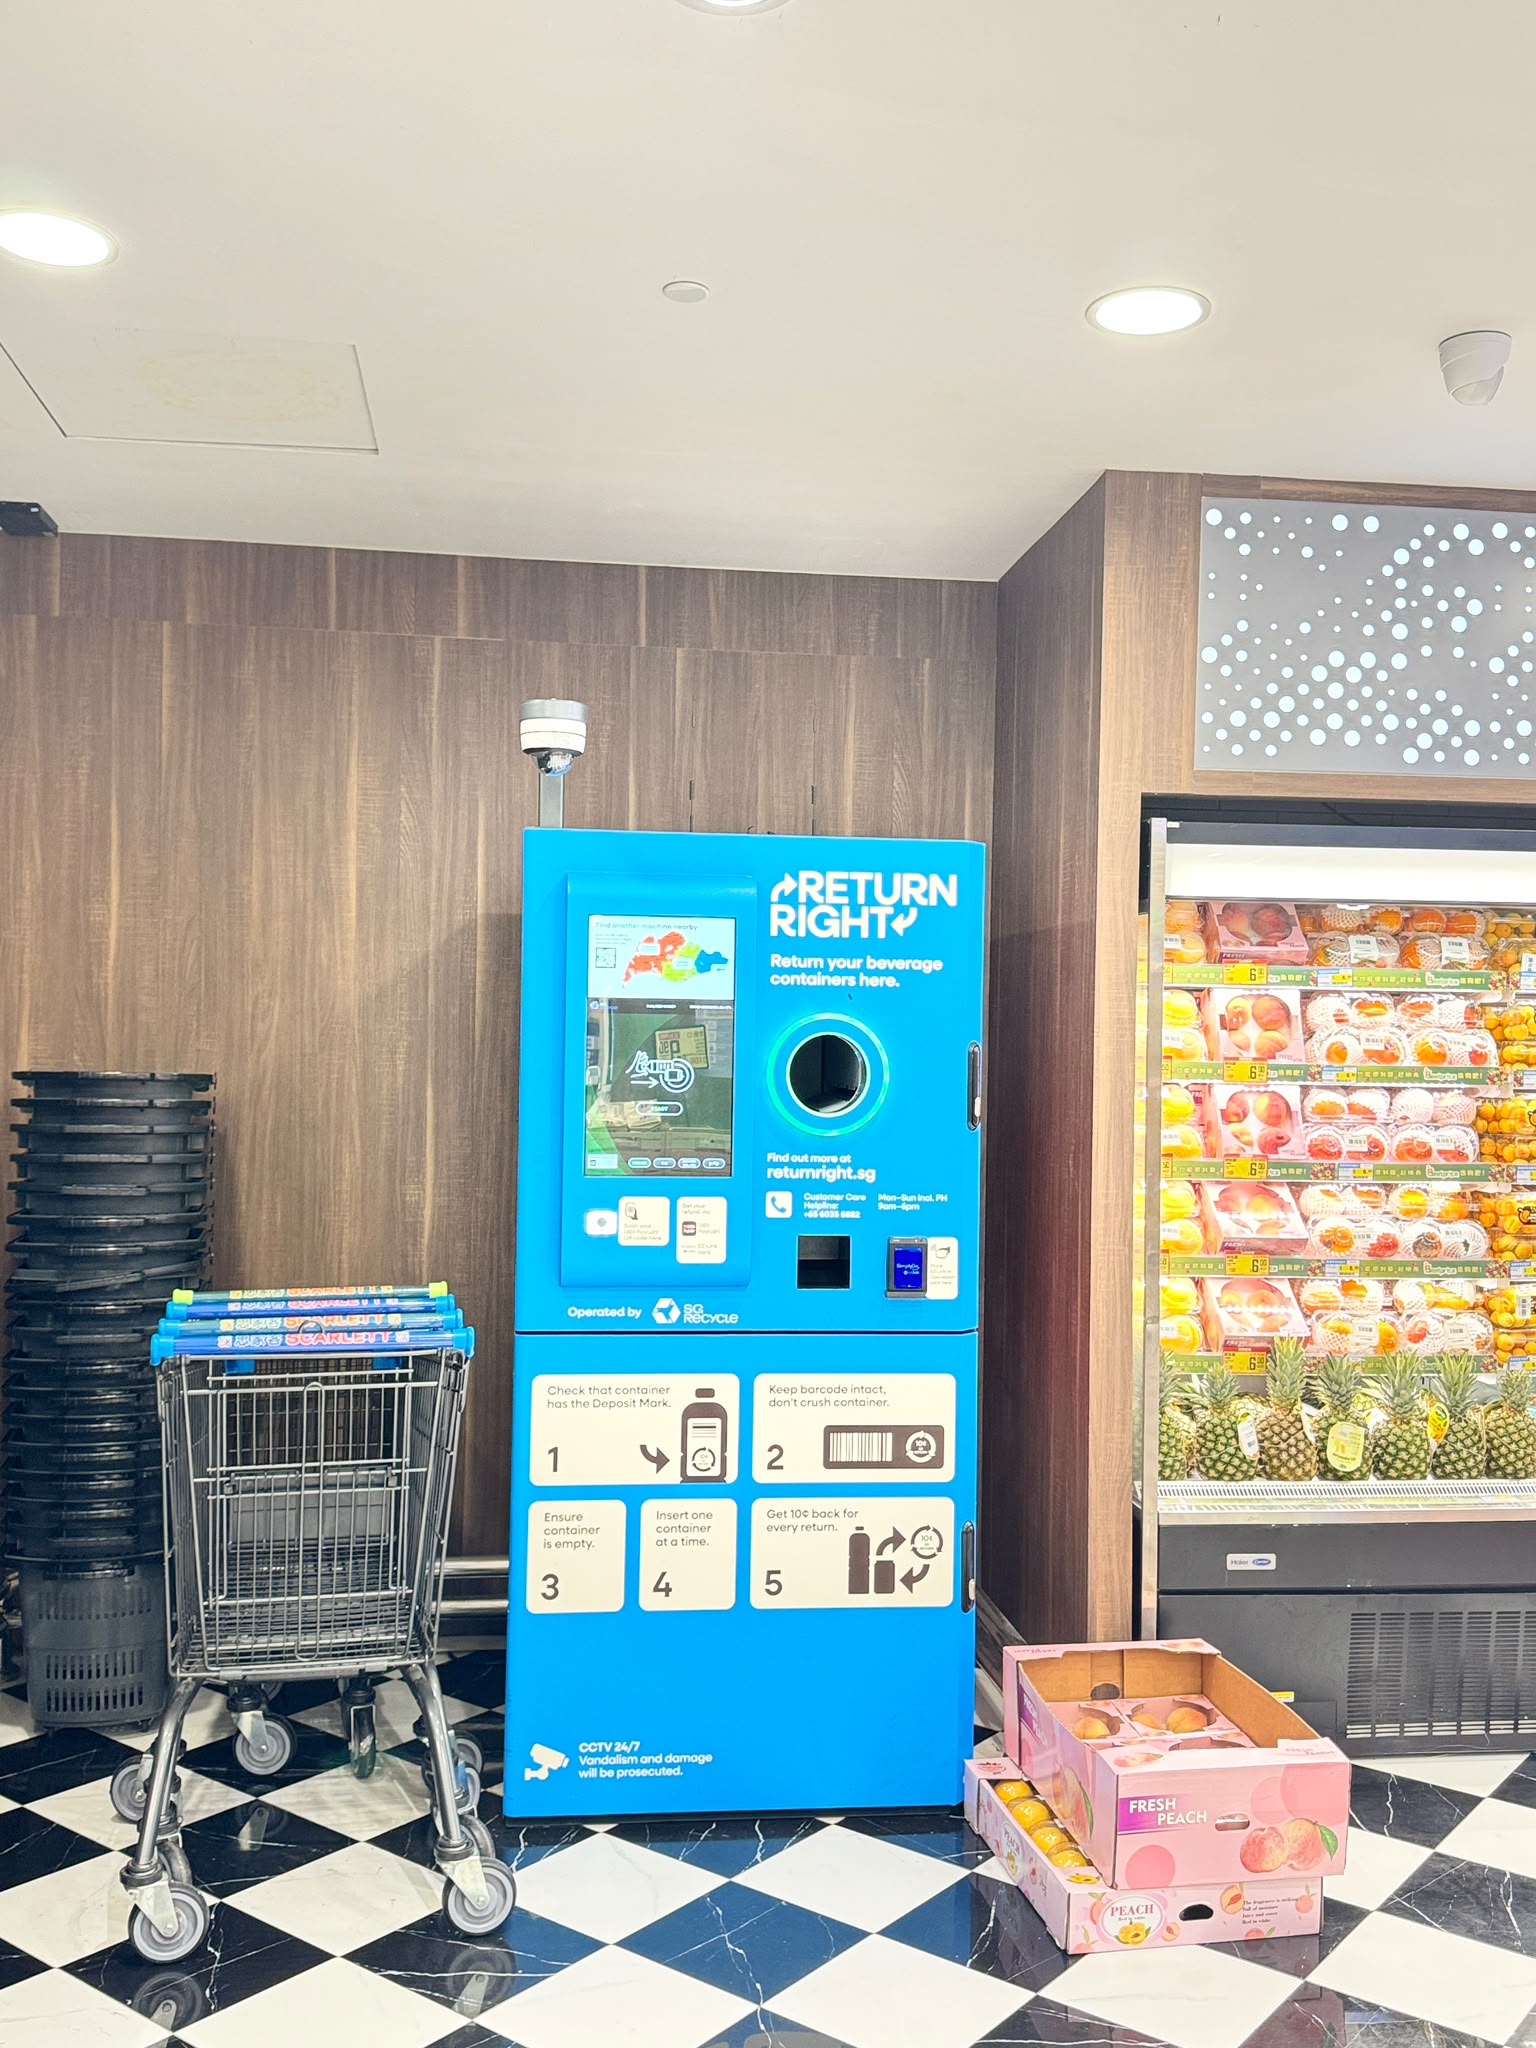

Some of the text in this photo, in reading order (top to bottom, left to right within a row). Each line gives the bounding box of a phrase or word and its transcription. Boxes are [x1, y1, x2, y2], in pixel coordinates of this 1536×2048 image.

[799, 870, 957, 907] RETURN
[770, 904, 894, 939] RIGHT
[770, 953, 943, 974] Return your beverage
[770, 972, 900, 987] containers here.
[1250, 968, 1256, 982] 6
[1250, 1066, 1257, 1079] 6
[767, 1152, 852, 1164] Find out more at
[767, 1165, 876, 1183] returnright.sg
[1250, 1163, 1257, 1176] 6
[803, 1192, 867, 1202] Customer Care
[917, 1194, 935, 1202] incl.
[935, 1194, 949, 1202] PH
[803, 1201, 839, 1210] Helpline:
[803, 1210, 818, 1219] +65
[1252, 1259, 1259, 1272] 6
[567, 1305, 643, 1319] Operated by
[683, 1303, 704, 1314] SG
[285, 1331, 393, 1346] SCARLETT
[1249, 1357, 1265, 1371] 6 00
[547, 1385, 670, 1396] Check that container
[769, 1384, 887, 1396] Keep barcode intact,
[547, 1398, 672, 1410] has the Deposit Mark.
[769, 1397, 890, 1407] don't crush container.
[547, 1446, 559, 1473] 1
[767, 1444, 784, 1470] 2
[544, 1512, 584, 1522] Ensure
[656, 1511, 714, 1521] Insert one
[767, 1508, 860, 1519] Get 10¢ back for
[543, 1525, 601, 1536] container
[656, 1523, 712, 1534] container
[766, 1522, 838, 1534] every return.
[543, 1538, 596, 1551] is empty.
[655, 1537, 710, 1547] at a time.
[541, 1573, 560, 1601] 3
[653, 1571, 673, 1598] 4
[765, 1570, 783, 1596] 5
[578, 1741, 641, 1754] CCTV 24/7
[578, 1753, 713, 1766] Vandalism and damage
[578, 1765, 684, 1780] will be prosecuted.
[1129, 1797, 1177, 1814] FRESH
[1157, 1810, 1207, 1826] PEACH
[1111, 1903, 1154, 1917] PEACH
